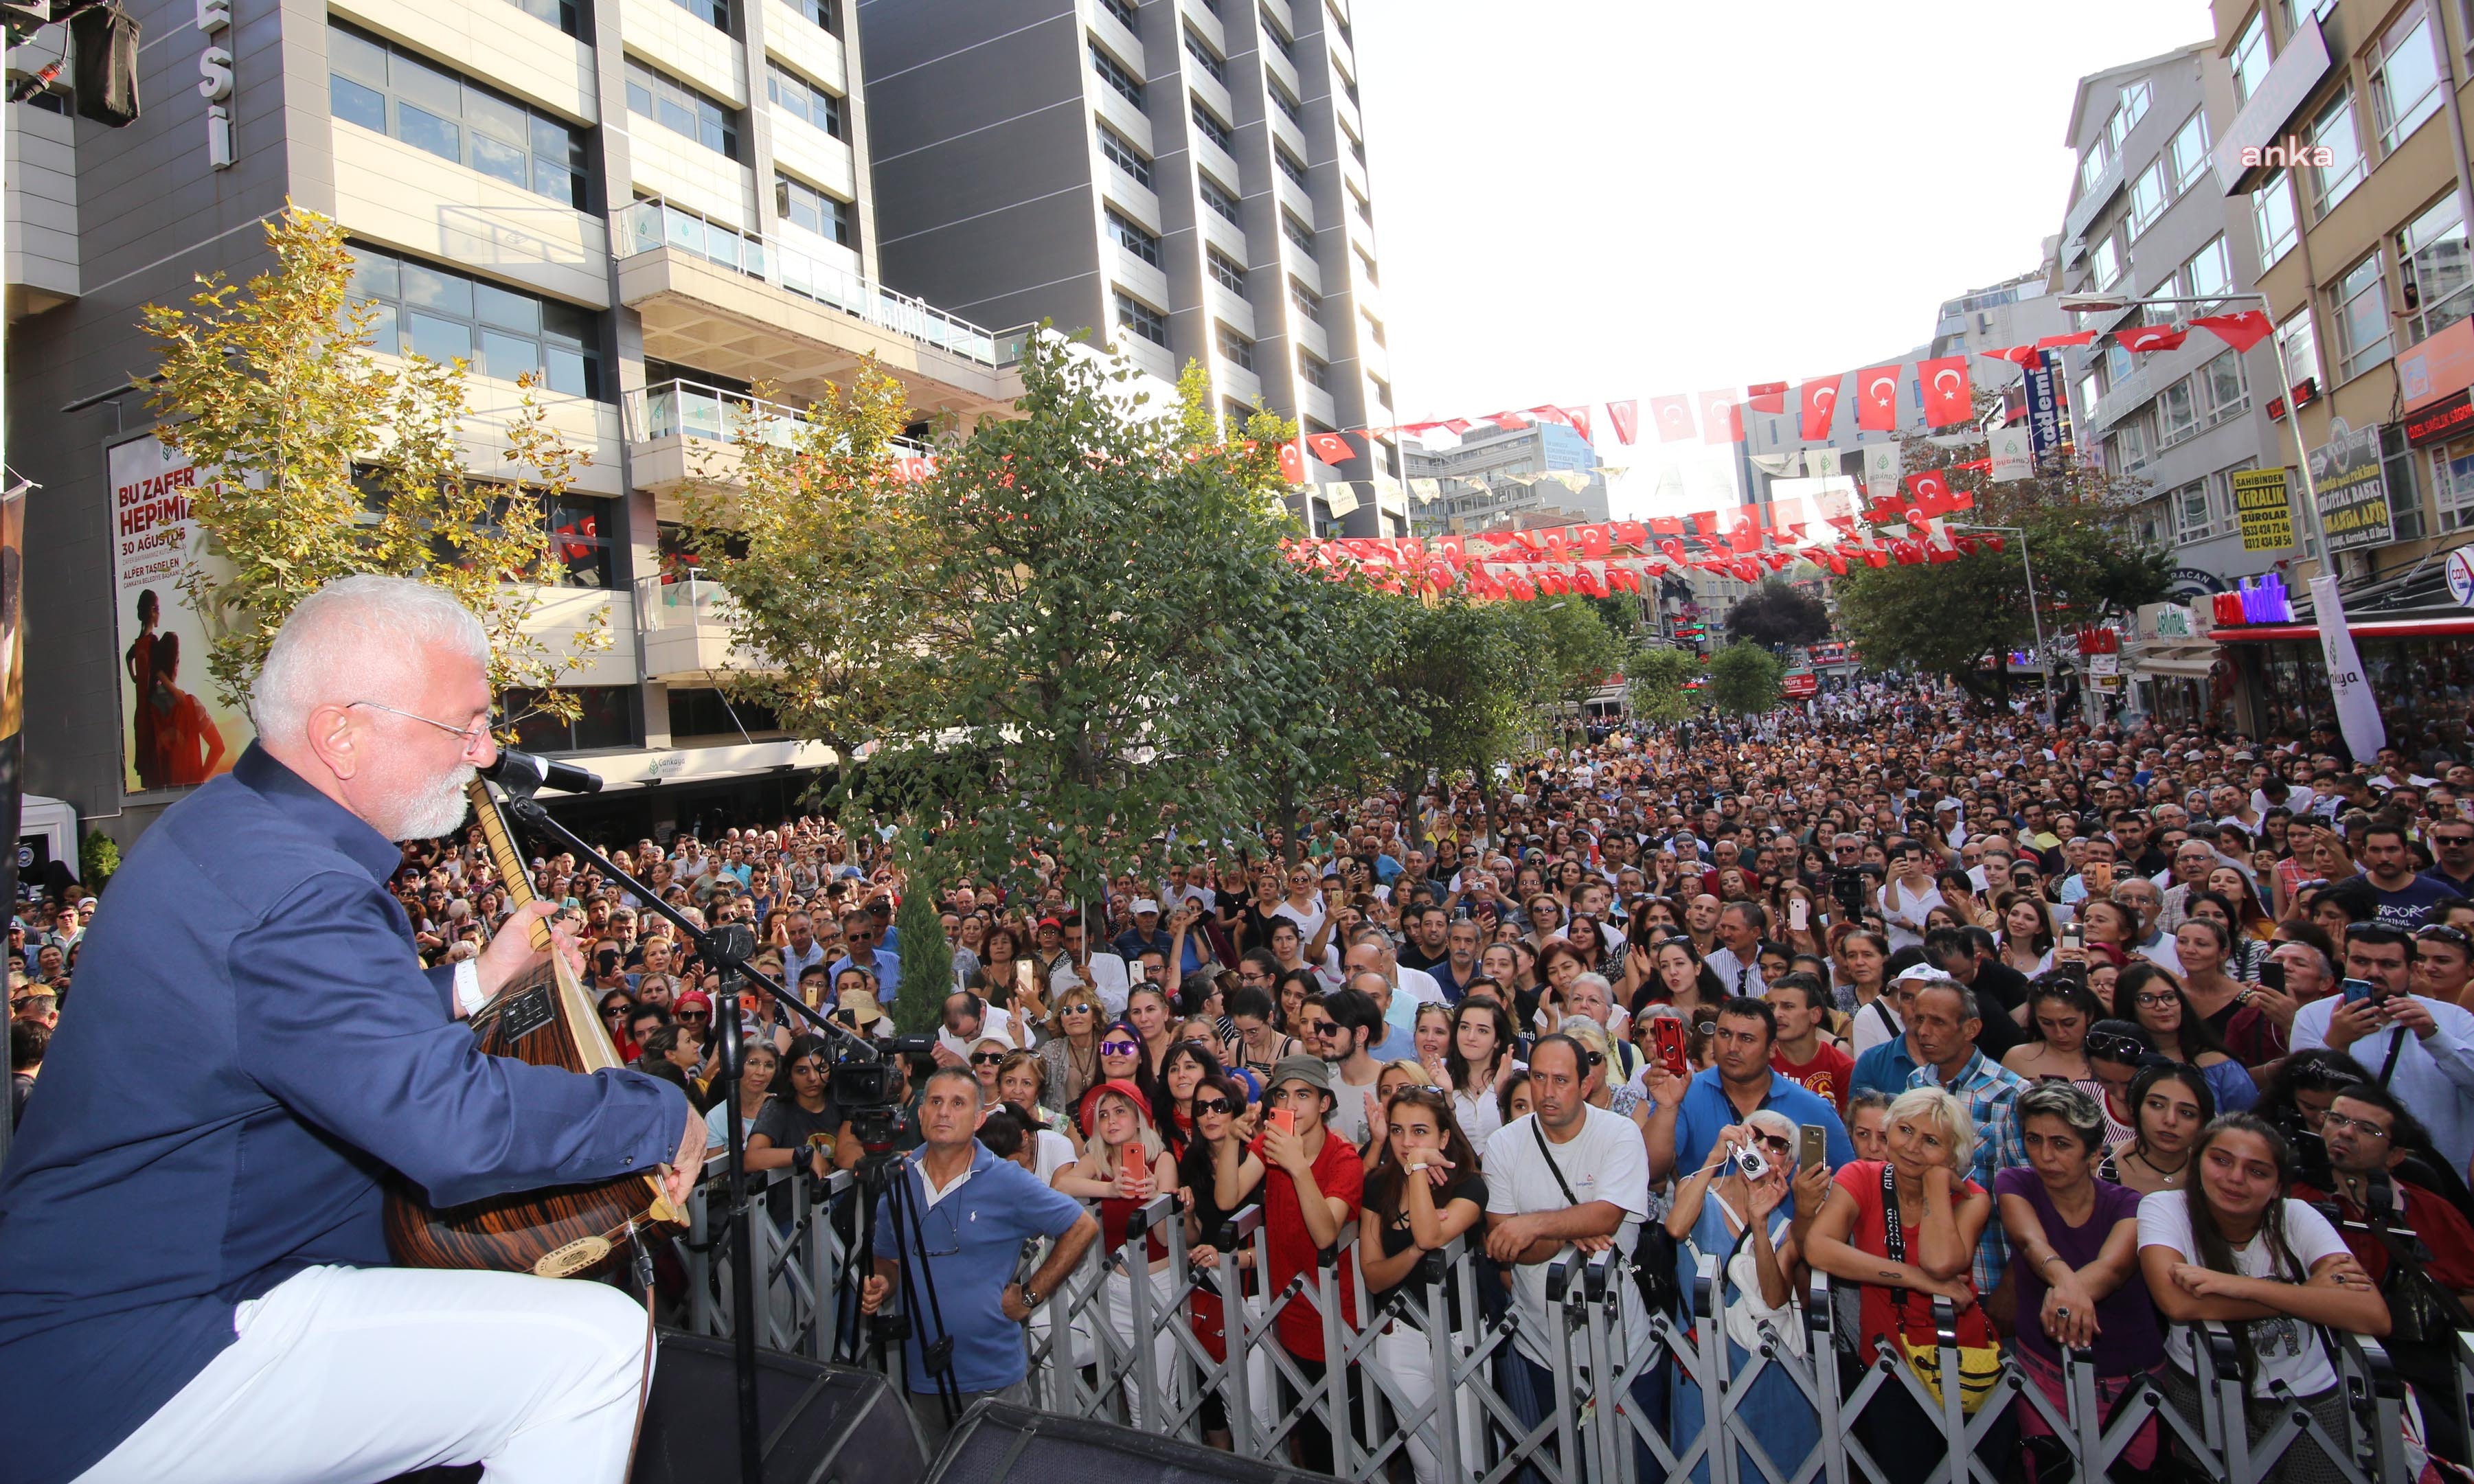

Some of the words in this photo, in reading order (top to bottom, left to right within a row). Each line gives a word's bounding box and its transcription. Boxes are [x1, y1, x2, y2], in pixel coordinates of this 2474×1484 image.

[119, 483, 139, 507] BU
[143, 466, 195, 501] ZAFER
[2236, 473, 2284, 488] SAHİBİNDEN
[2237, 486, 2286, 508] KİRALIK
[2350, 480, 2381, 503] BASKI
[2241, 510, 2287, 523] BÜROLAR
[2243, 525, 2258, 536] 0533
[2259, 524, 2271, 534] 424
[2272, 523, 2280, 533] 72
[2282, 522, 2290, 532] 46
[122, 541, 135, 556] 30
[2244, 538, 2260, 549] 0312
[2261, 537, 2273, 547] 434
[2283, 535, 2292, 545] 56
[124, 567, 144, 580] ALPER
[146, 558, 179, 575] TAŞDELEN
[124, 579, 142, 589] ÇANKAYA
[142, 574, 161, 584] BELEDİYE
